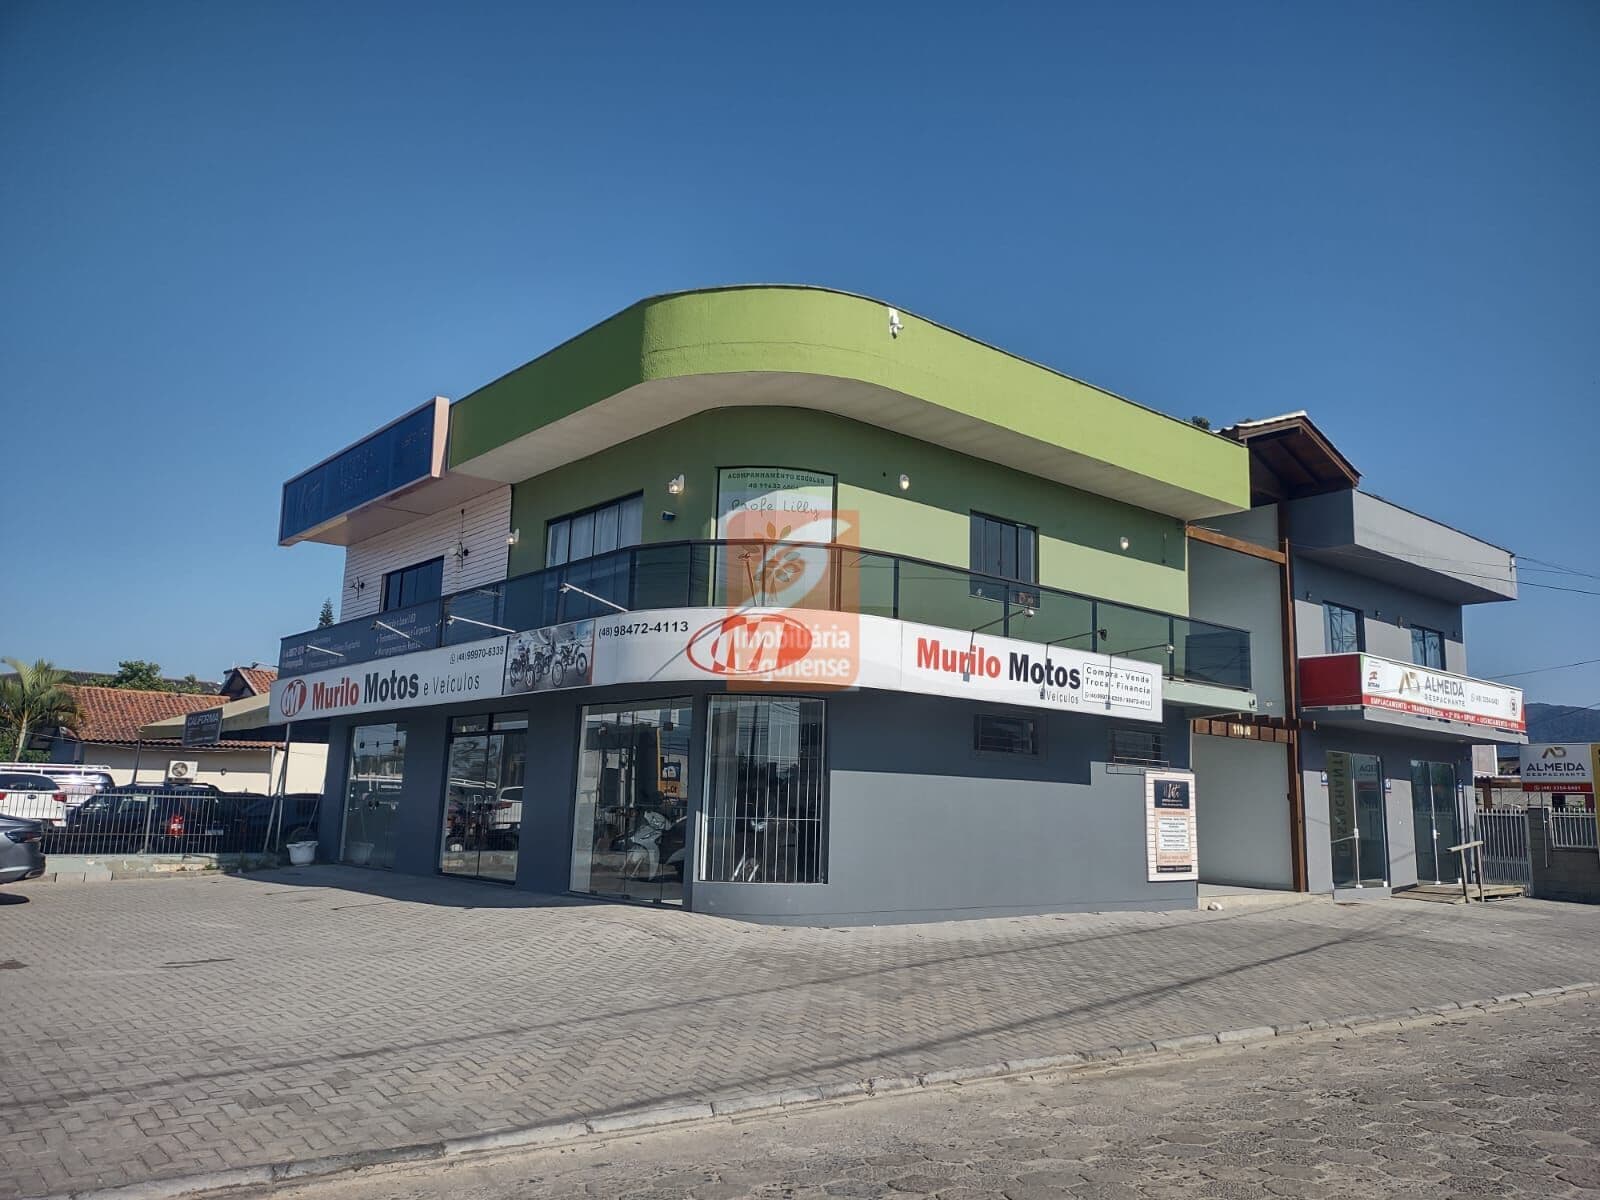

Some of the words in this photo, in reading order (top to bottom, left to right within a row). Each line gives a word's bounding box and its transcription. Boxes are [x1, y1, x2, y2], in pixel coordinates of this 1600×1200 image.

[783, 500, 819, 521] Lilly
[917, 637, 1001, 678] Murilo
[1008, 651, 1081, 690] Motos
[1086, 666, 1118, 679] Compra
[1125, 673, 1150, 683] Vende
[312, 676, 359, 711] Murilo
[363, 670, 419, 705] Motos
[423, 684, 429, 696] e
[432, 672, 480, 695] Veículos
[1085, 677, 1109, 688] Troca
[1116, 682, 1151, 694] Financia
[1424, 676, 1465, 698] ALMEIDA
[1046, 690, 1079, 705] Veículos
[1370, 697, 1407, 710] EMPLACAMENTO
[1424, 694, 1465, 708] DESPACHANTE
[1526, 762, 1586, 772] ALMEIDA
